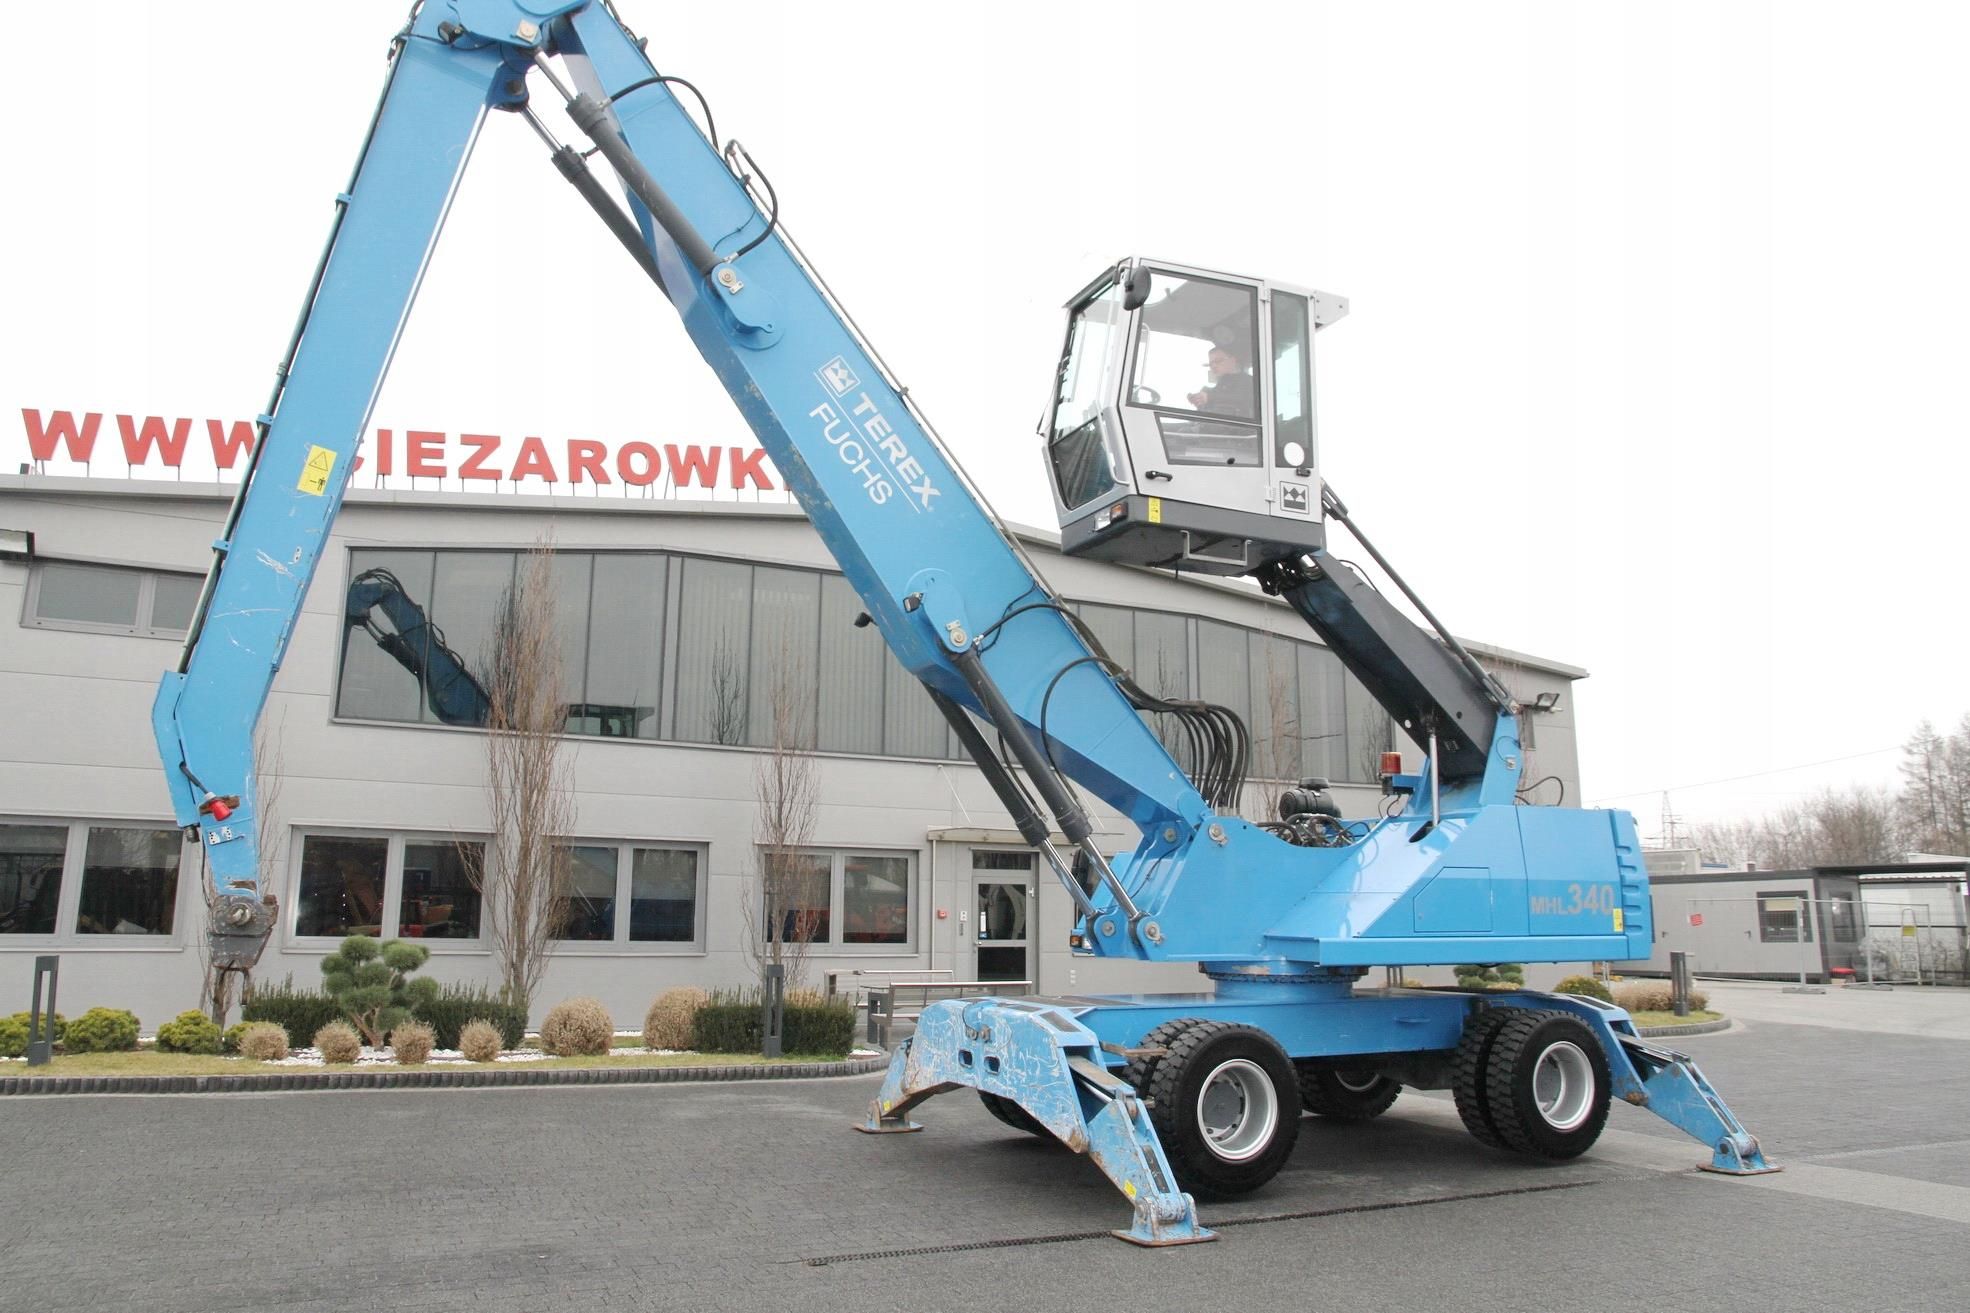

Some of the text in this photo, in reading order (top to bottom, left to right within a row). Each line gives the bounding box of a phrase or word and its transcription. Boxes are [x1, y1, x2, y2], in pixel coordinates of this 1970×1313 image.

[352, 428, 793, 491] IEZAROWK
[809, 402, 893, 505] FUCHS
[853, 391, 942, 509] TEREX
